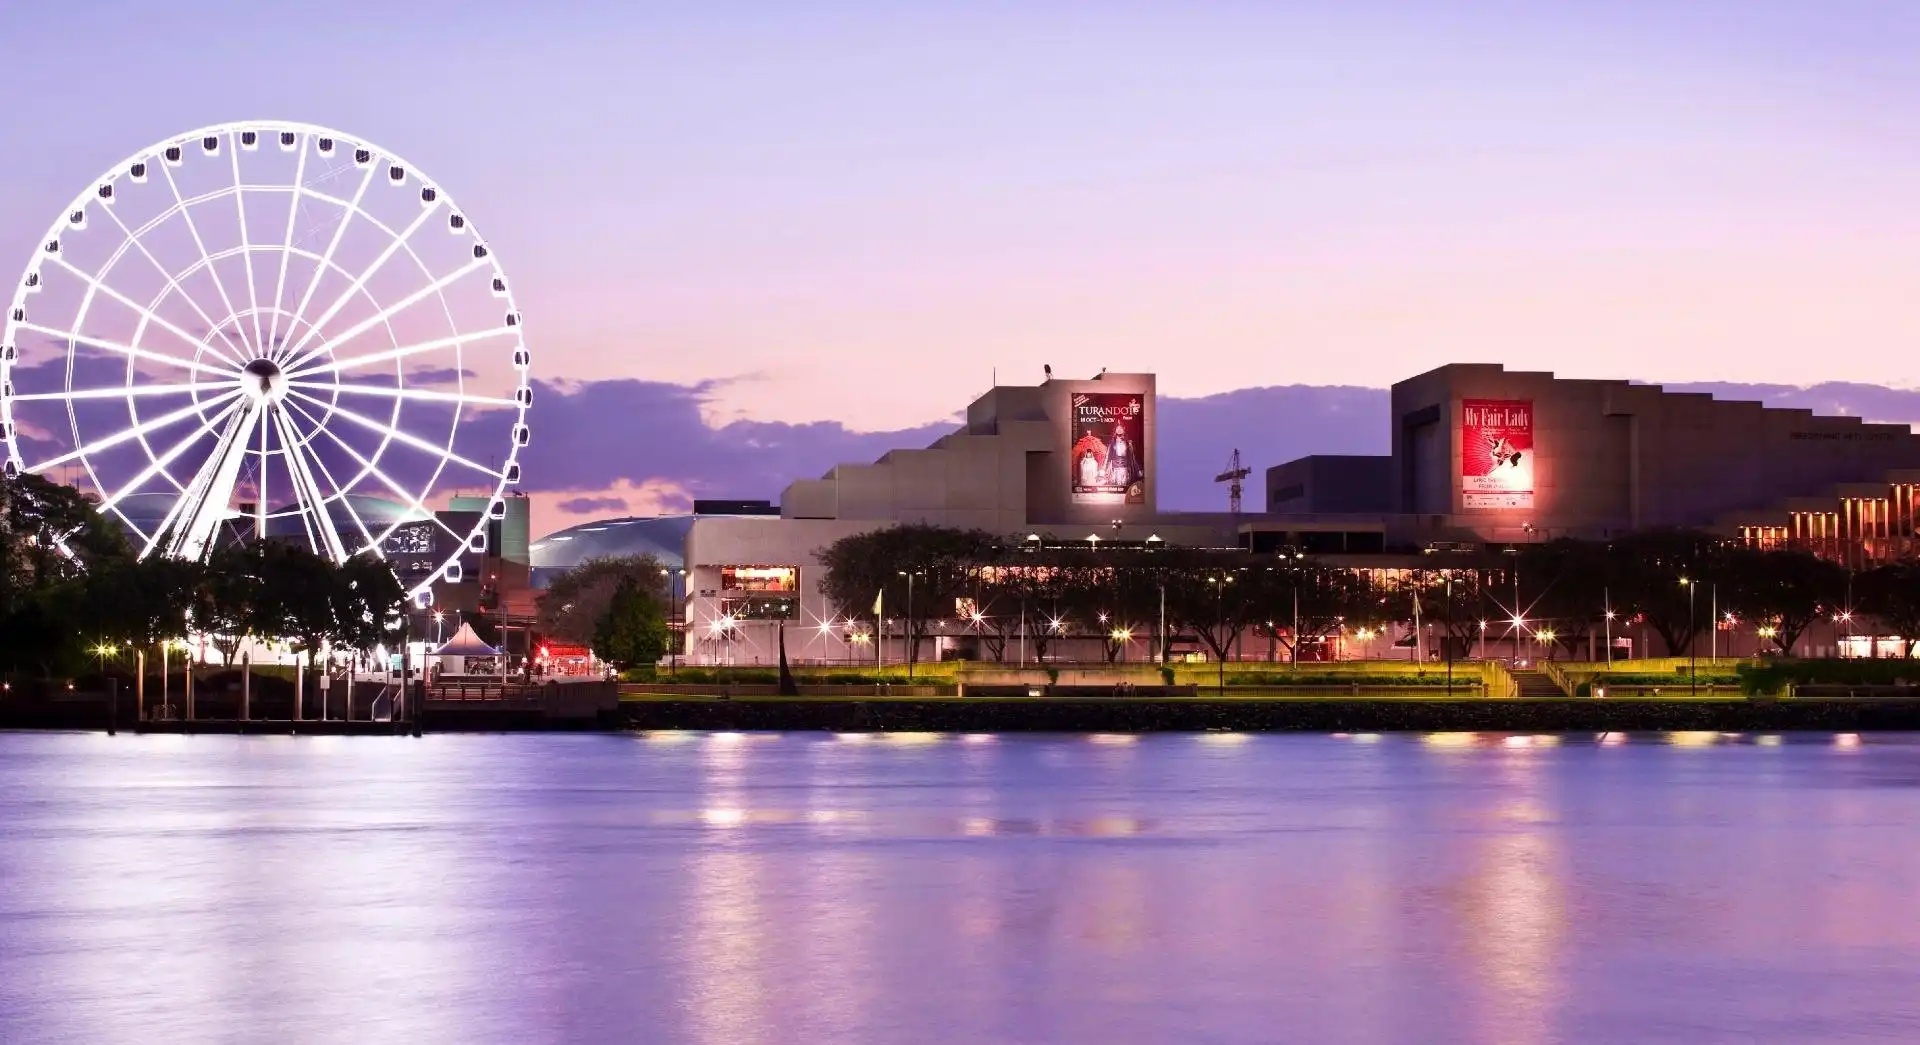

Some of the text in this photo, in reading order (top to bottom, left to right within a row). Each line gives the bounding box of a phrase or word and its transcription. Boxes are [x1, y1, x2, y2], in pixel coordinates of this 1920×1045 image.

[1465, 408, 1528, 430] My Fair Lady
